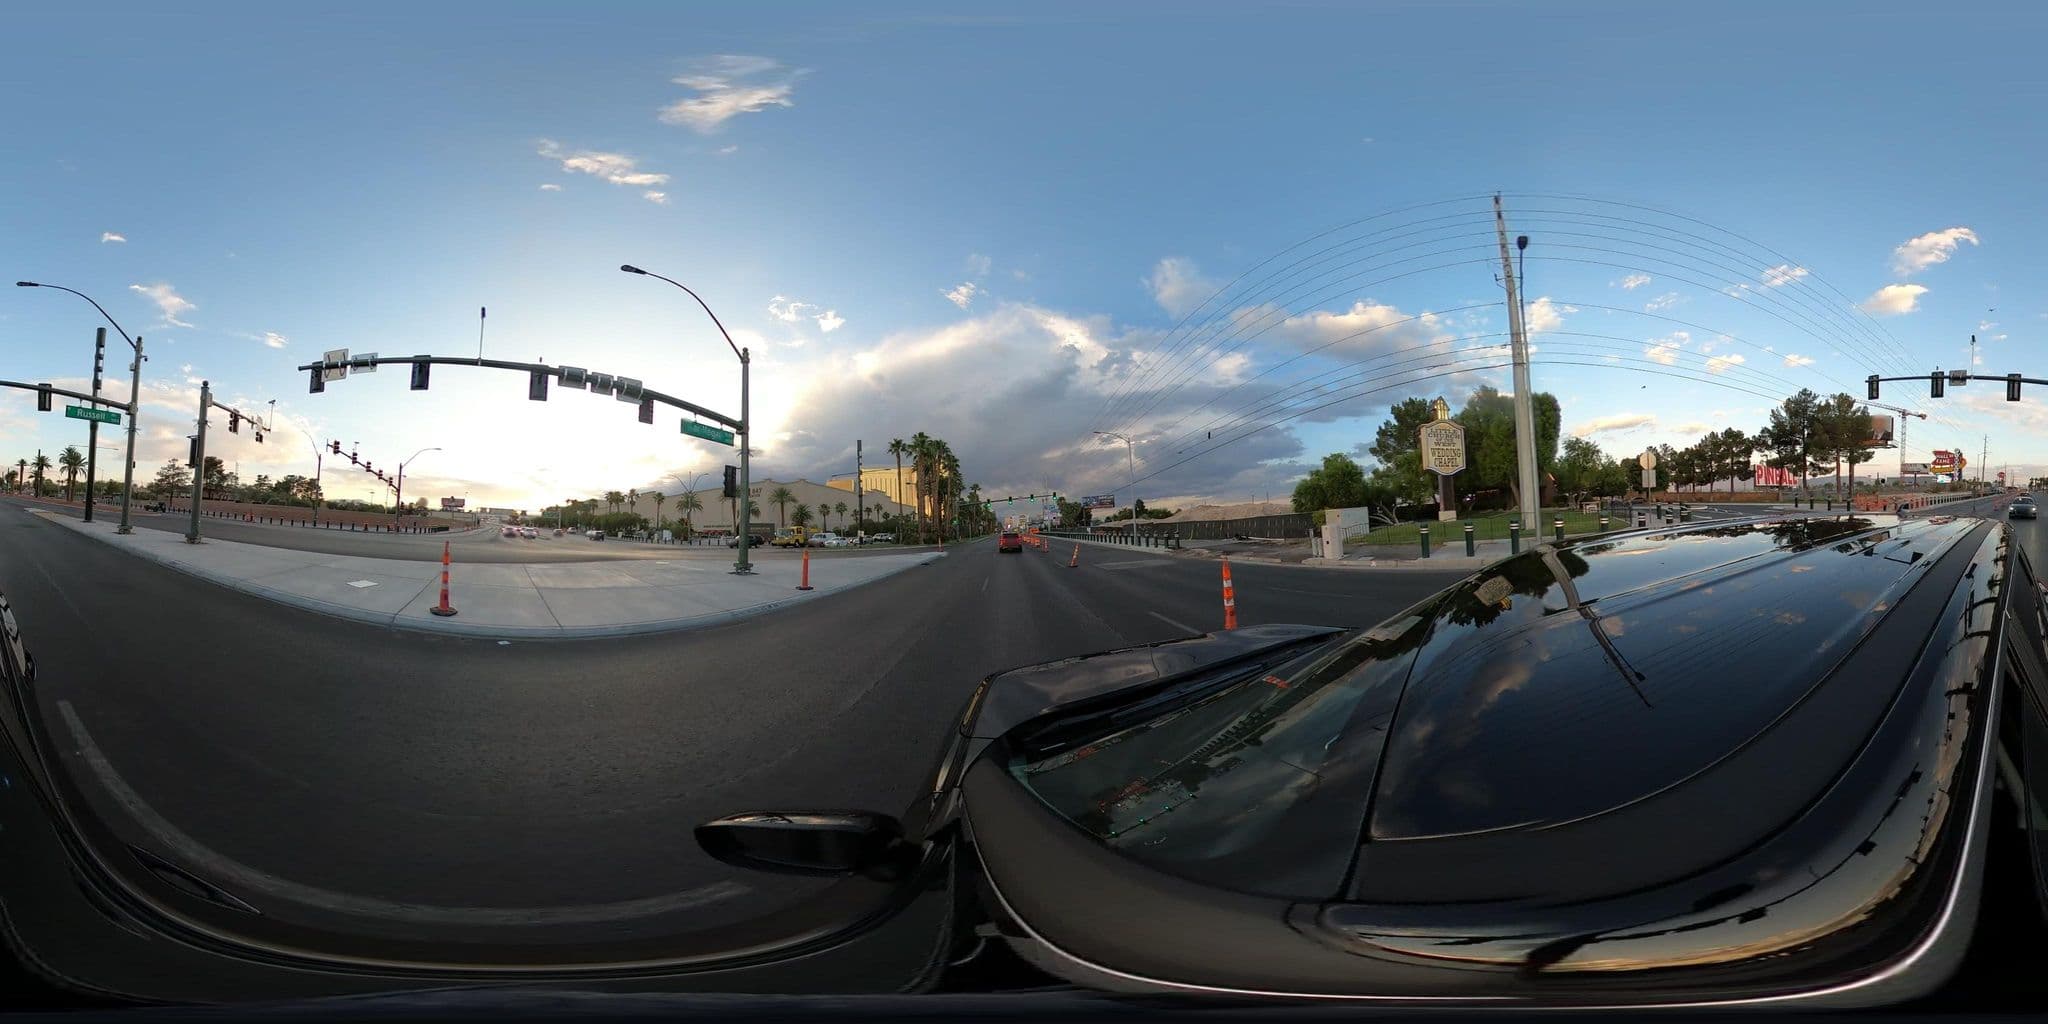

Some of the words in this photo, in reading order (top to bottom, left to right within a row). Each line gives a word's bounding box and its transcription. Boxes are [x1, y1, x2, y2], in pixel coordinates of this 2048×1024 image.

[77, 409, 106, 420] Russell
[1431, 448, 1461, 457] WEDDING
[1434, 457, 1459, 467] CHAPEL
